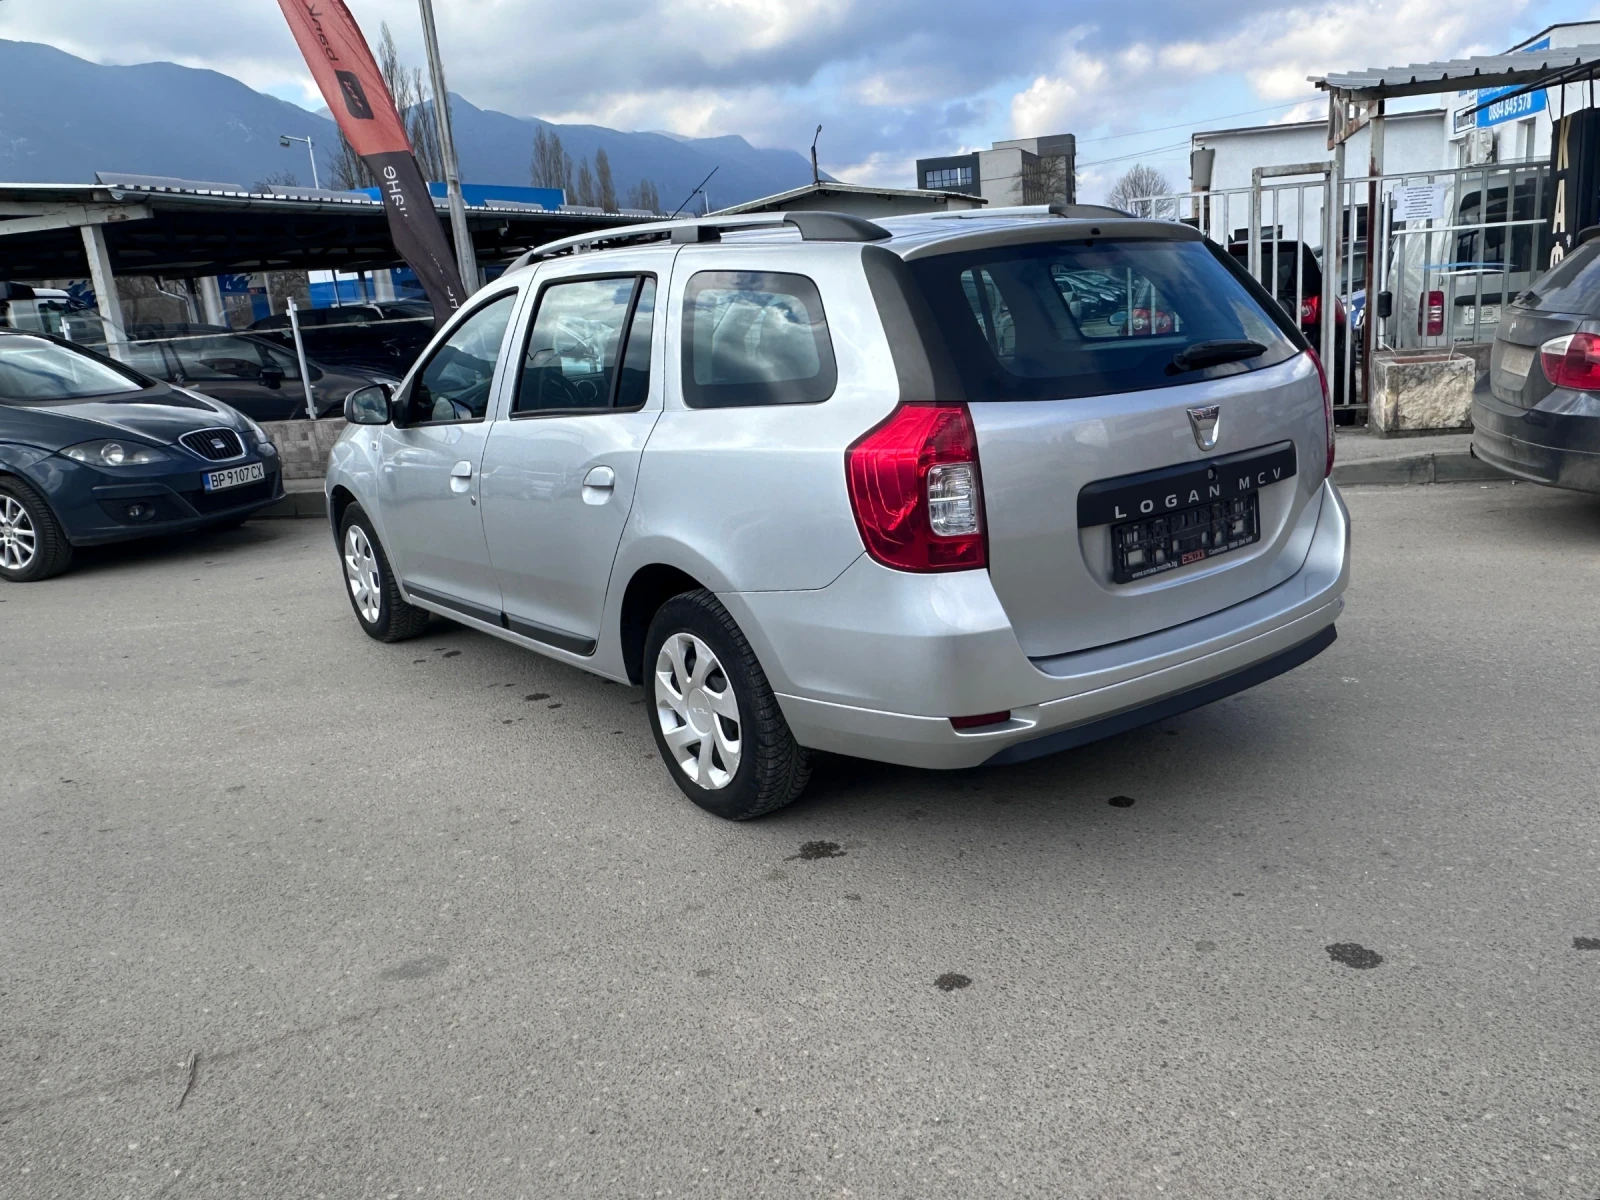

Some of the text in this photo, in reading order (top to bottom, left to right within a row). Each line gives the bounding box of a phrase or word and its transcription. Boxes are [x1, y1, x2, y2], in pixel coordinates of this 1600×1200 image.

[210, 463, 263, 488] BP 9107 CX
[1114, 467, 1282, 519] LOGAN MCV
